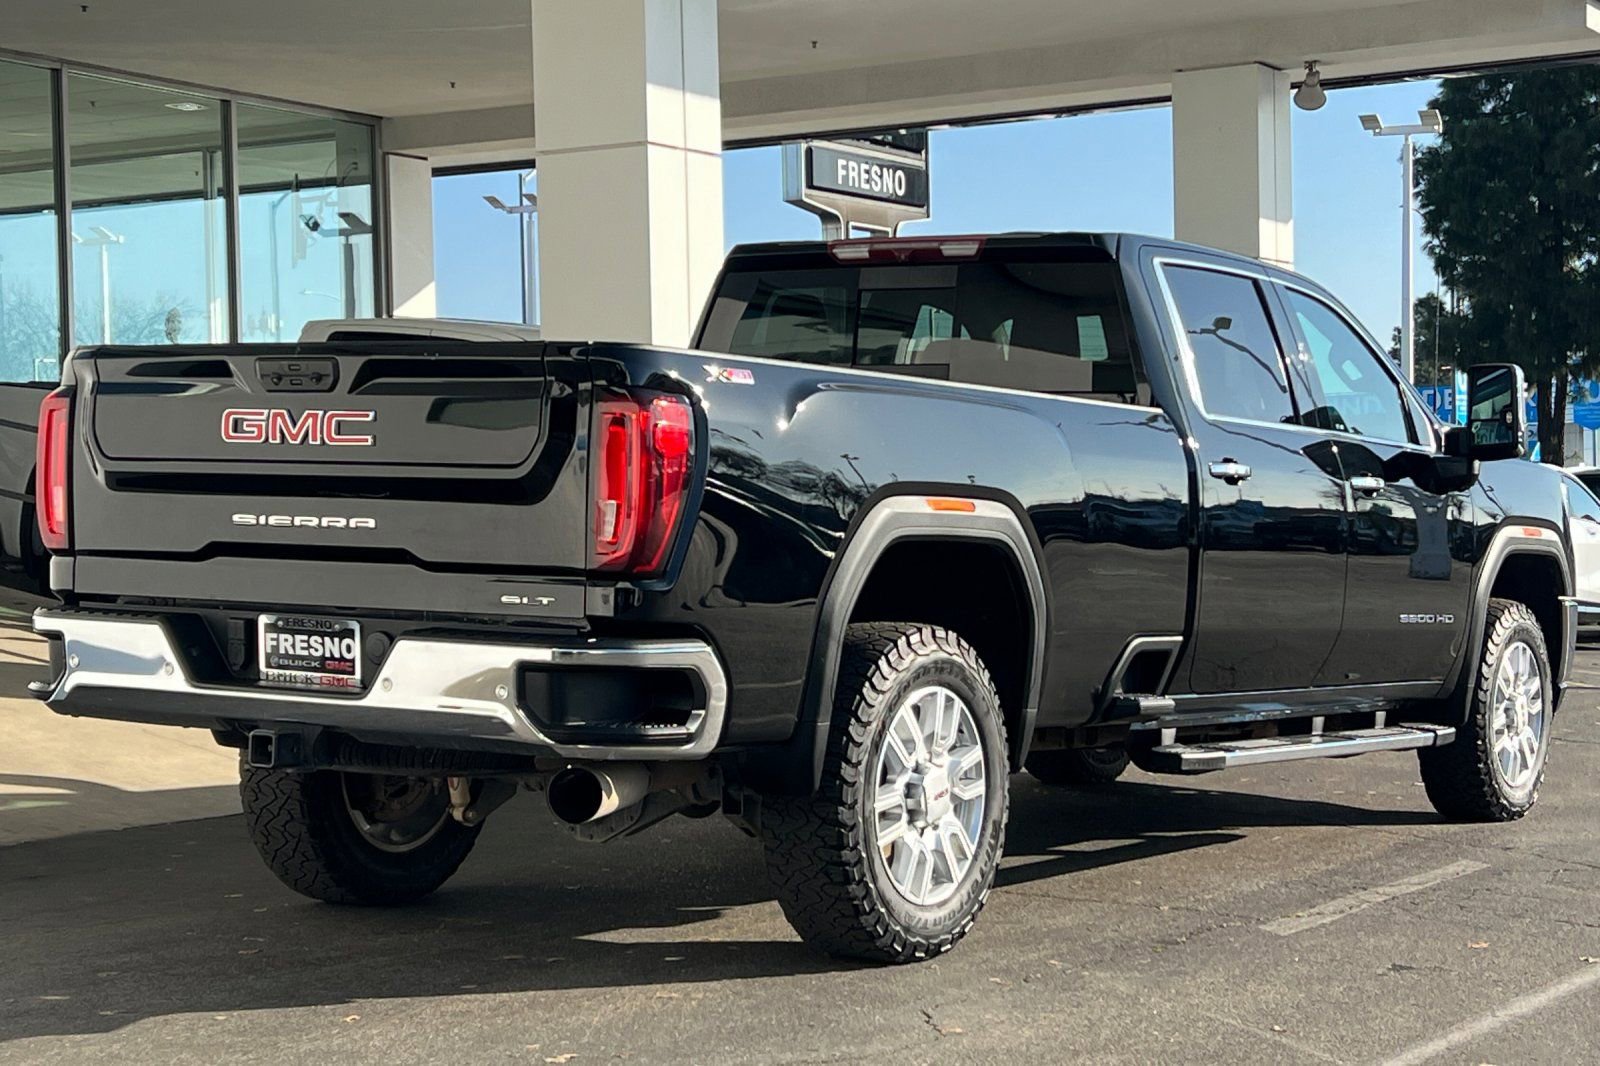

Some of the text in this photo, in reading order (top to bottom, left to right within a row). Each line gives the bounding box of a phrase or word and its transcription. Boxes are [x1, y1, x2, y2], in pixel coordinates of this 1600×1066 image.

[837, 158, 907, 197] FRESNO
[221, 408, 376, 446] GMC
[231, 513, 376, 529] SIERRA
[500, 595, 556, 605] SLT
[286, 618, 333, 631] FRESNO
[1436, 614, 1455, 624] HD
[264, 632, 356, 660] FRESNO
[279, 658, 354, 672] BUICK GMC
[319, 675, 358, 688] GMC
